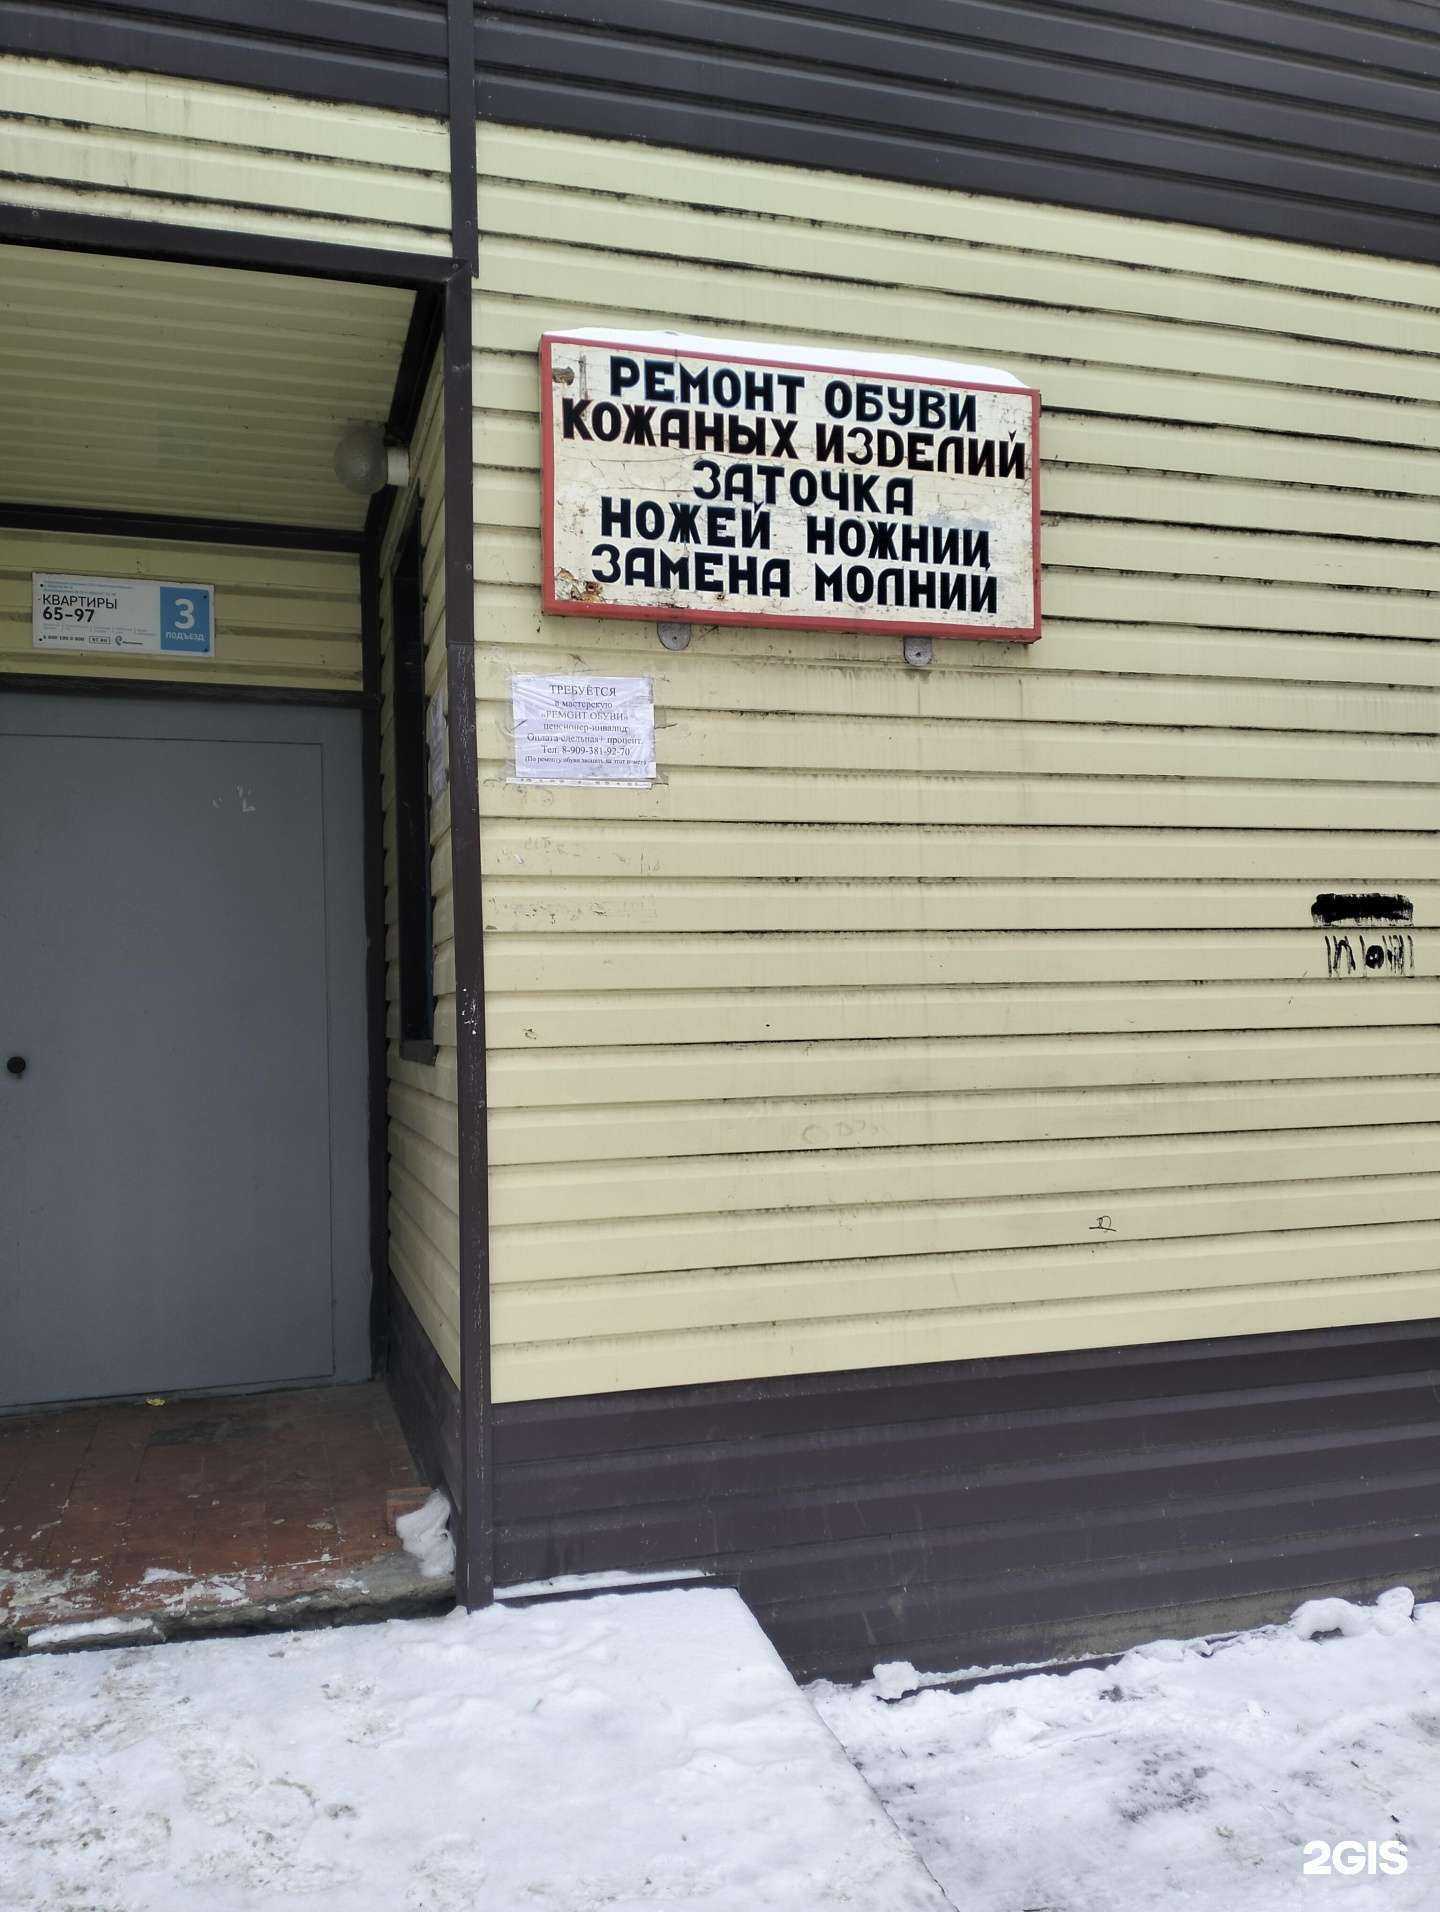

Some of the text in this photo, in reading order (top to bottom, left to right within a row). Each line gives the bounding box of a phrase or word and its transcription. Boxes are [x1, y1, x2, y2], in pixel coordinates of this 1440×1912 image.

[609, 355, 977, 433] РЕМОНТ ОБУВИ
[562, 397, 1026, 480] КОЖАНЫХ ИЗДЕЛИЙ
[693, 459, 914, 516] ЗАТОЧКА
[600, 496, 771, 550] НОЖЕЙ
[592, 543, 998, 614] ЗАМЕНА МОЛНИИ
[42, 593, 118, 610] КВАРТИРЫ
[42, 606, 96, 623] 65-97
[173, 598, 196, 630] 3
[550, 684, 617, 697] ТРЕБУЕТСЯ
[561, 700, 613, 710] мастерскую
